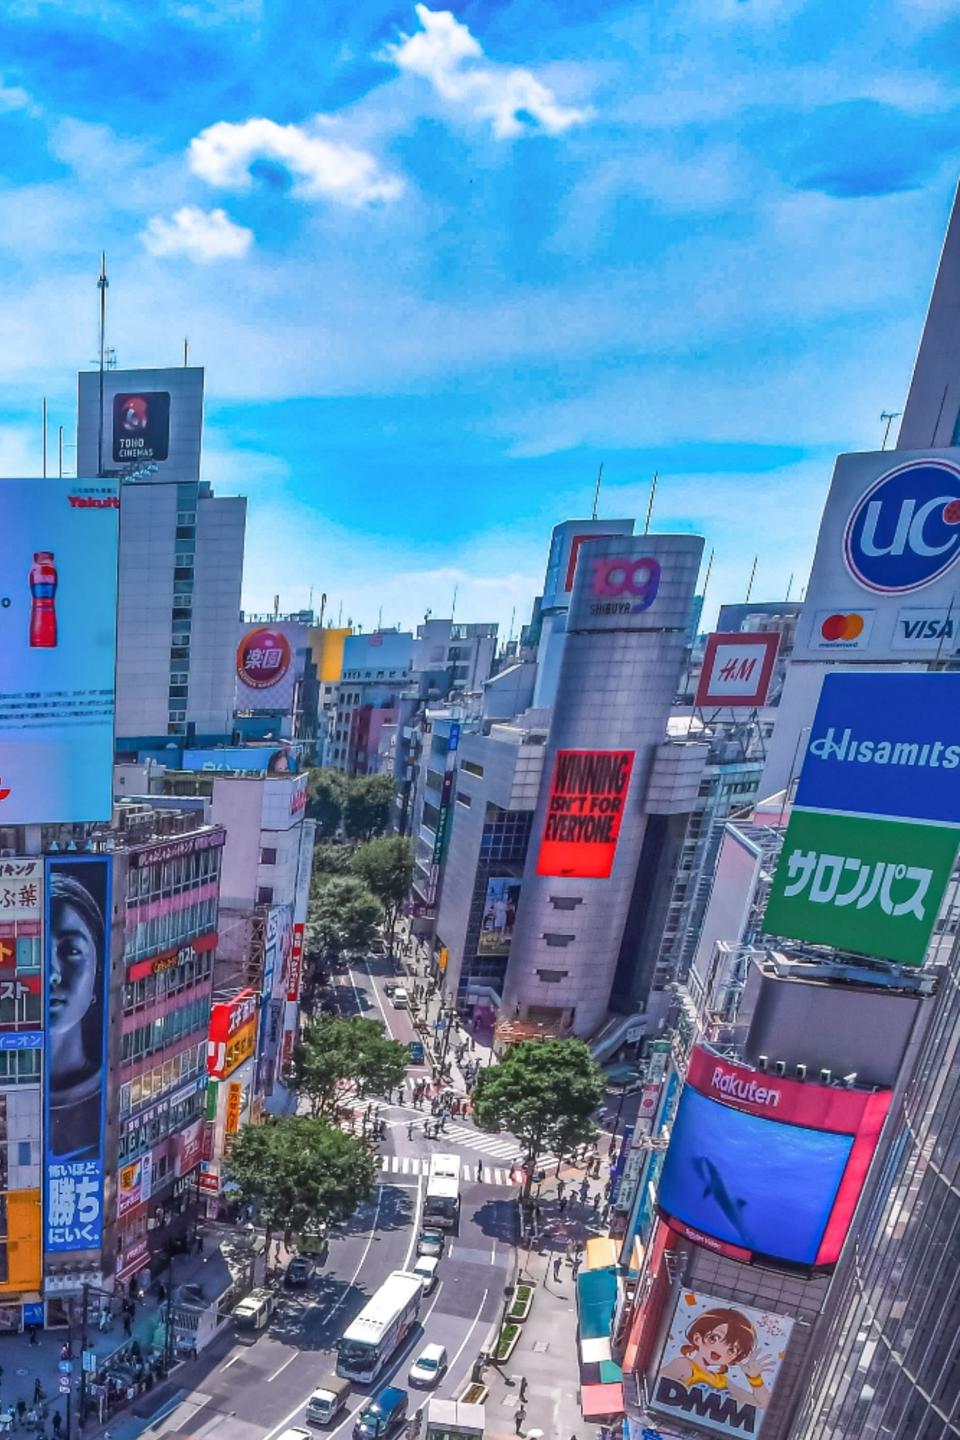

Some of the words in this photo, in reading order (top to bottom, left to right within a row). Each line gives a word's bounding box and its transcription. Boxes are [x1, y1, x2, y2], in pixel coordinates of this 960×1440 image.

[119, 448, 154, 457] CINEMAS
[120, 438, 144, 448] TOHO
[594, 557, 662, 614] 109
[591, 602, 631, 615] SHIBUYA
[900, 620, 954, 639] VISA
[720, 657, 754, 681] H&M
[556, 754, 628, 795] WINNING
[551, 796, 587, 814] ISN'T
[591, 796, 623, 813] FOR
[544, 814, 618, 844] EVERYONE.
[785, 848, 934, 921] サロンパス
[711, 1067, 781, 1107] Rakuten
[48, 1177, 99, 1227] 勝ち
[657, 1376, 757, 1436] DMM
